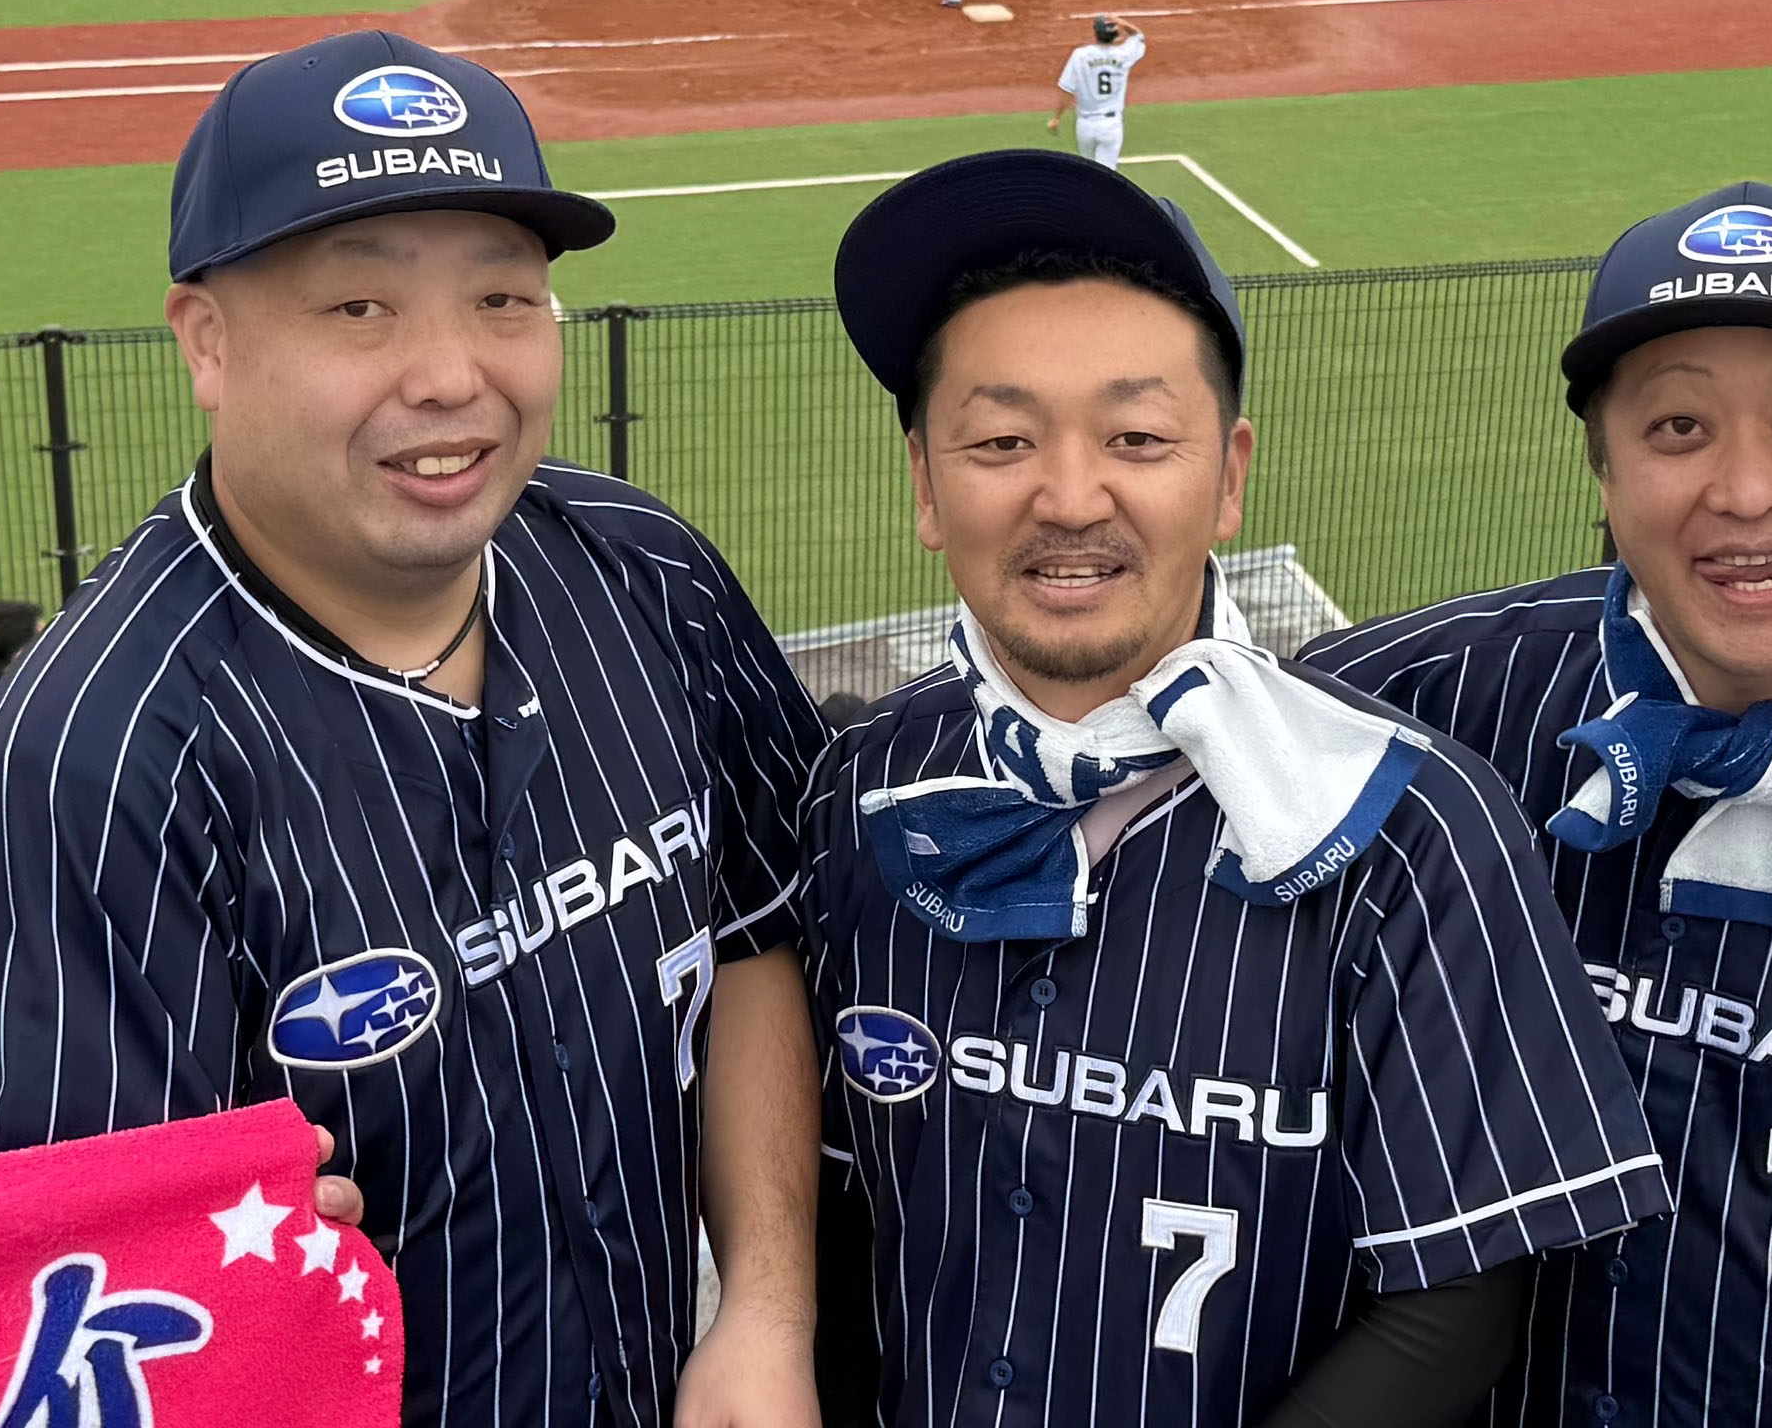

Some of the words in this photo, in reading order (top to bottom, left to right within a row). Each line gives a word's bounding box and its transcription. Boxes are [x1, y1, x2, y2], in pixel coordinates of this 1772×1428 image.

[1098, 71, 1112, 94] 6
[315, 147, 503, 189] SUBARU
[1607, 741, 1636, 828] SUBARU
[905, 879, 966, 934] SUBARU
[1274, 835, 1356, 904] SUBARU
[656, 925, 714, 1091] 7
[949, 1035, 1328, 1148] SUBARU
[1140, 1197, 1239, 1355] 7
